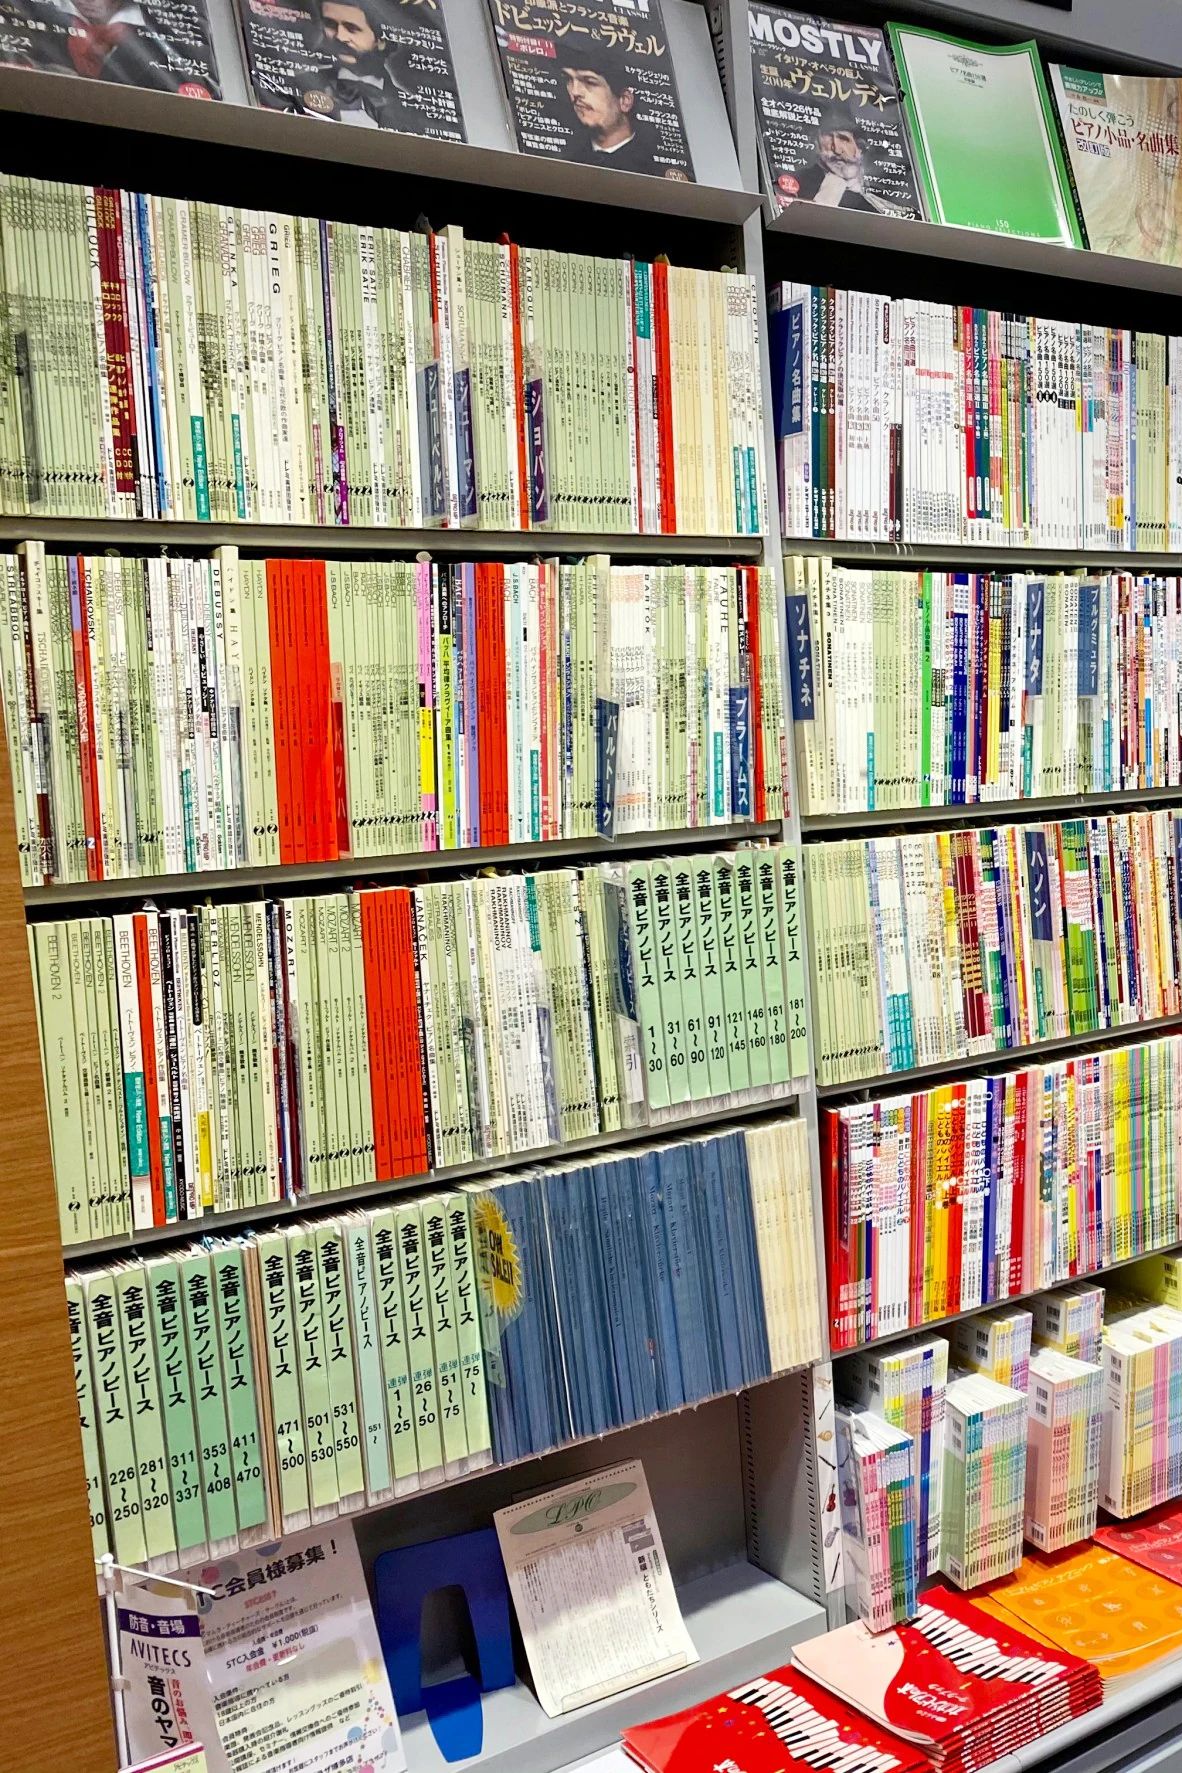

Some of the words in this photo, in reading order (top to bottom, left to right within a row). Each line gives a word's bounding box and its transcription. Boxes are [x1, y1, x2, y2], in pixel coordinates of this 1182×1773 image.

[747, 11, 882, 66] MOSTLY
[775, 54, 864, 80] イタリア・オペラの巨人
[1069, 103, 1135, 127] たのしく弾こう
[1070, 117, 1180, 156] ピアノ小品・名曲集
[84, 194, 99, 270] GILLOCK
[227, 216, 239, 288] GLINKA
[269, 223, 281, 294] GRIEG
[499, 253, 508, 319] SCHUMANN
[752, 284, 760, 344] CHOPIN
[790, 312, 802, 434] ピアノ名曲集
[532, 386, 545, 509] ショパン
[6, 565, 20, 641] STREABBOG
[85, 567, 96, 641] TCHAIKOVSKY
[213, 569, 224, 640] DEBUSSY
[795, 603, 812, 708] ソナチネ
[1029, 590, 1043, 684] ソナタ
[1089, 588, 1100, 690] ブルグミュラー
[334, 730, 347, 818] バッハ
[606, 713, 619, 829] バルトーク
[735, 697, 749, 808] ブラームス
[737, 864, 758, 970] 全音ピアノピース
[758, 862, 779, 968] 全音ピアノピース
[782, 858, 801, 962] 全音ピアノピース
[1030, 850, 1048, 920] ハノン
[210, 918, 220, 988] BERLIOZ
[229, 915, 242, 983] MENDELSSOHN
[255, 912, 264, 968] MENDELSSOHN
[284, 910, 296, 977] MOZART
[631, 877, 655, 988] 全音ピアノピース
[653, 873, 677, 983] 全音ピアノピース
[675, 871, 697, 981] 全音ピアノピース
[696, 869, 717, 978] 全音ピアノピース
[716, 866, 738, 973] 全音ピアノピース
[119, 930, 131, 988] BEETHOVEN
[149, 928, 160, 985] BEETHOVEN
[648, 1026, 656, 1038] 1
[667, 1020, 681, 1034] 31
[687, 1018, 702, 1032] 61
[708, 1014, 721, 1028] 91
[727, 1011, 743, 1024] 121
[747, 1007, 764, 1020] 146
[767, 1004, 784, 1017] 161
[789, 998, 805, 1011] 181
[790, 1026, 807, 1040] 200
[649, 1058, 663, 1073] 30
[670, 1052, 685, 1067] 60
[690, 1049, 705, 1064] 90
[710, 1046, 725, 1060] 120
[729, 1039, 746, 1053] 145
[749, 1036, 766, 1050] 160
[770, 1033, 786, 1047] 180
[320, 1240, 347, 1362] 全音ピアノピース
[354, 1236, 373, 1350] 全音ピアノピース
[375, 1229, 401, 1347] 全音ピアノピース
[401, 1223, 427, 1342] 全音ピアノピース
[426, 1215, 452, 1333] 全音ピアノピース
[450, 1210, 475, 1326] 全音ピアノピース
[156, 1279, 187, 1408] 全音ピアノピース
[187, 1273, 218, 1401] 全音ピアノピース
[219, 1264, 248, 1390] 全音ピアノピース
[264, 1255, 292, 1378] 全音ピアノピース
[295, 1249, 322, 1372] 全音ピアノピース
[91, 1294, 124, 1424] 全音ピアノピース
[122, 1286, 155, 1416] 全音ピアノピース
[387, 1375, 407, 1390] 連弾
[413, 1368, 433, 1383] 連弾
[439, 1360, 459, 1374] 連弾
[461, 1351, 480, 1366] 連弾
[110, 1467, 135, 1487] 226
[140, 1457, 164, 1477] 281
[281, 1453, 305, 1471] 500
[114, 1503, 140, 1523] 250
[144, 1493, 169, 1512] 320
[128, 1614, 185, 1635] 防音・音場
[643, 1573, 663, 1633] ともだちシリーズ
[130, 1638, 191, 1668] AVITECS
[170, 1678, 188, 1726] 音のお悩み
